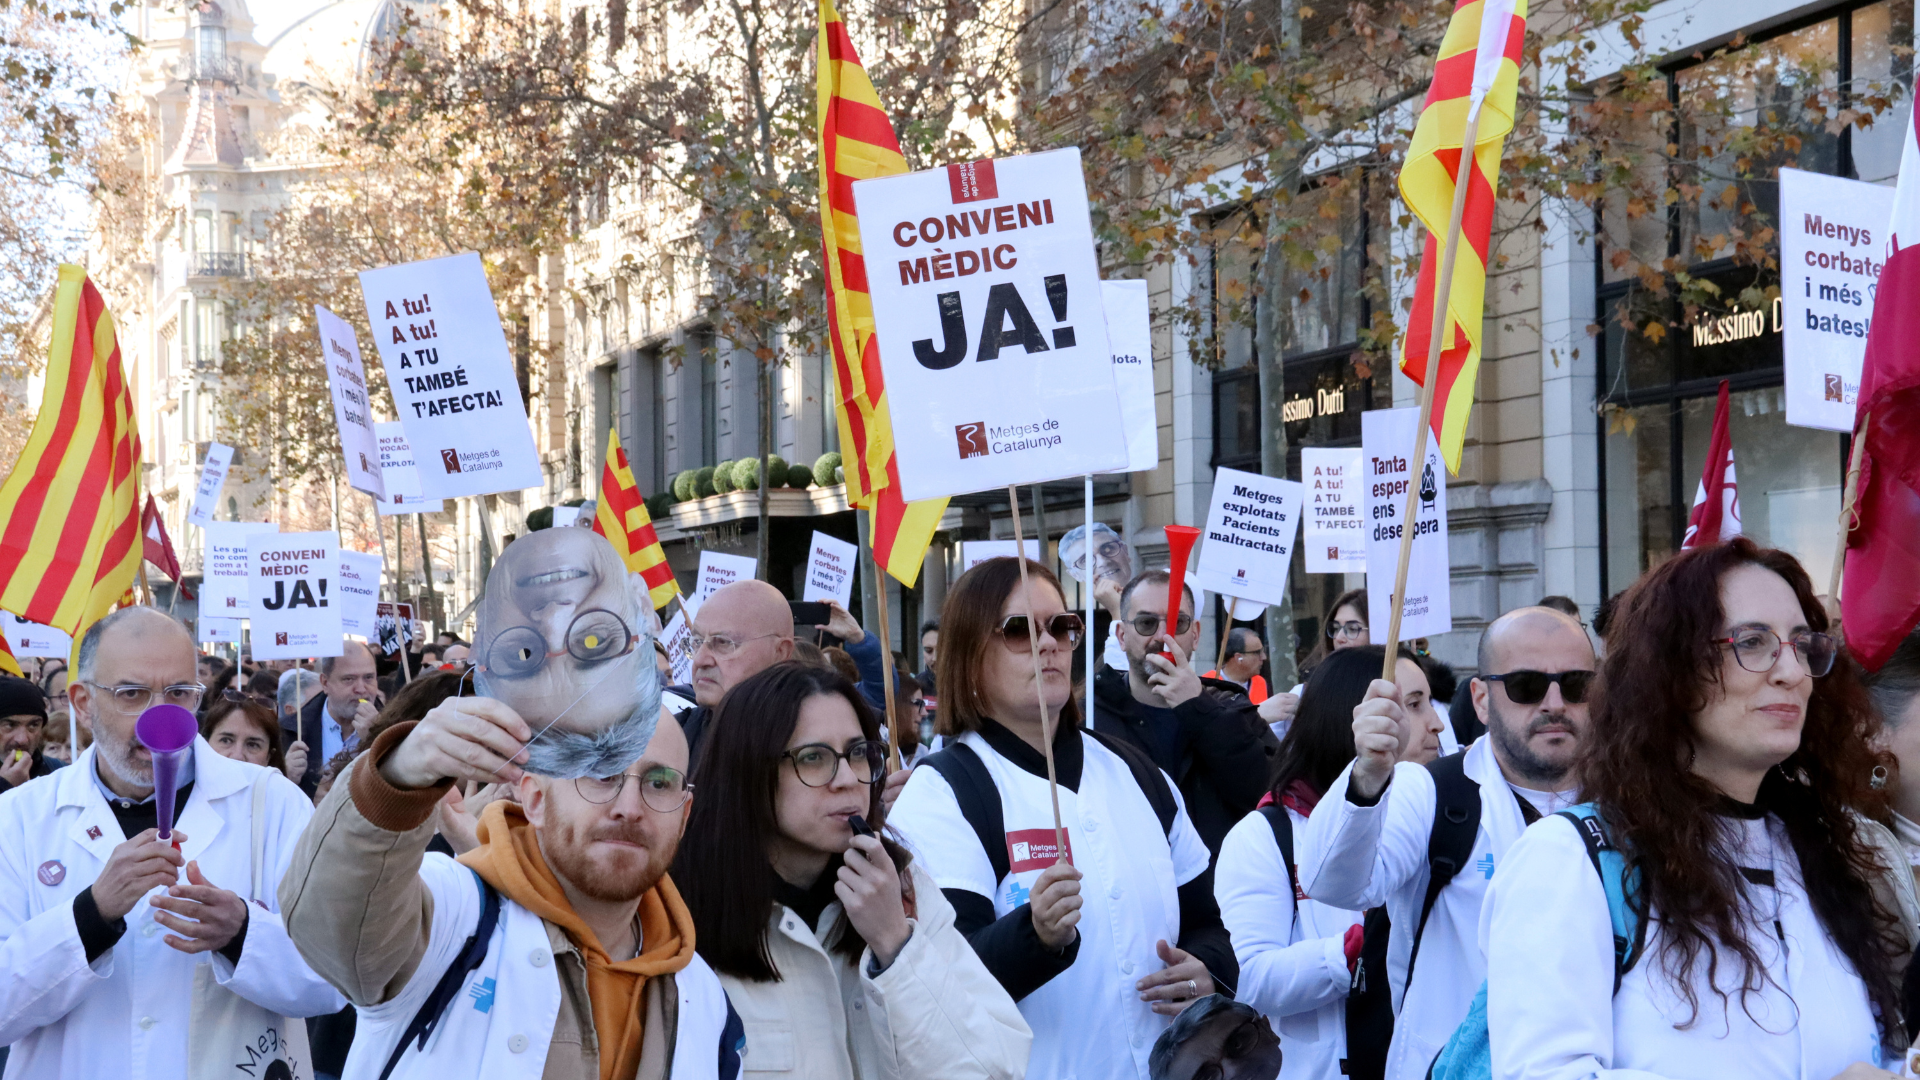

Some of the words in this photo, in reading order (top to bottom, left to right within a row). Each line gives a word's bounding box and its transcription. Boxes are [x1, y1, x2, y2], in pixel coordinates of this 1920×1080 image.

[967, 161, 977, 186] etges
[893, 199, 1054, 247] CONVENI
[1804, 213, 1871, 247] Menys
[898, 244, 1018, 286] MÈDIC
[1805, 276, 1811, 298] i
[1819, 283, 1862, 306] més
[385, 300, 399, 320] A
[402, 293, 432, 316] tu!
[392, 325, 407, 344] A
[409, 319, 438, 340] tu!
[912, 273, 1077, 370] JA!
[1806, 308, 1870, 339] bates!
[400, 352, 412, 369] A
[414, 347, 439, 366] TU
[404, 365, 469, 394] TAMBÉ
[411, 390, 503, 418] T'AFECTA!
[1317, 384, 1344, 416] Dutti
[990, 423, 1040, 439] Metges
[1042, 419, 1059, 431] de
[992, 435, 1062, 454] Catalunya
[459, 451, 490, 462] Metges
[490, 448, 500, 457] de
[1372, 455, 1407, 475] Tanta
[462, 460, 503, 473] Catalunya
[1314, 466, 1322, 476] A
[1326, 466, 1343, 476] tu!
[1314, 479, 1322, 489] A
[1326, 479, 1343, 489] tu!
[1372, 480, 1409, 500] esper
[1232, 485, 1283, 504] Metges
[1314, 494, 1322, 503] A
[1325, 493, 1341, 503] TU
[1223, 502, 1286, 522] explotats
[1315, 504, 1355, 516] TAMBÉ
[1372, 503, 1396, 520] ens
[1222, 516, 1280, 537] Pacients
[1315, 520, 1365, 529] T'AFECT
[1373, 519, 1439, 542] desepera
[213, 545, 230, 553] Les
[1209, 531, 1287, 554] maltractats
[260, 549, 325, 562] CONVENI
[816, 547, 840, 562] Menys
[260, 563, 309, 577] MÈDIC
[706, 565, 736, 576] Menys
[814, 559, 847, 576] corbates
[817, 571, 834, 581] més
[262, 578, 329, 611] JA!
[811, 578, 835, 592] bates!
[1030, 844, 1057, 852] Metges
[1031, 850, 1068, 859] Cataluna
